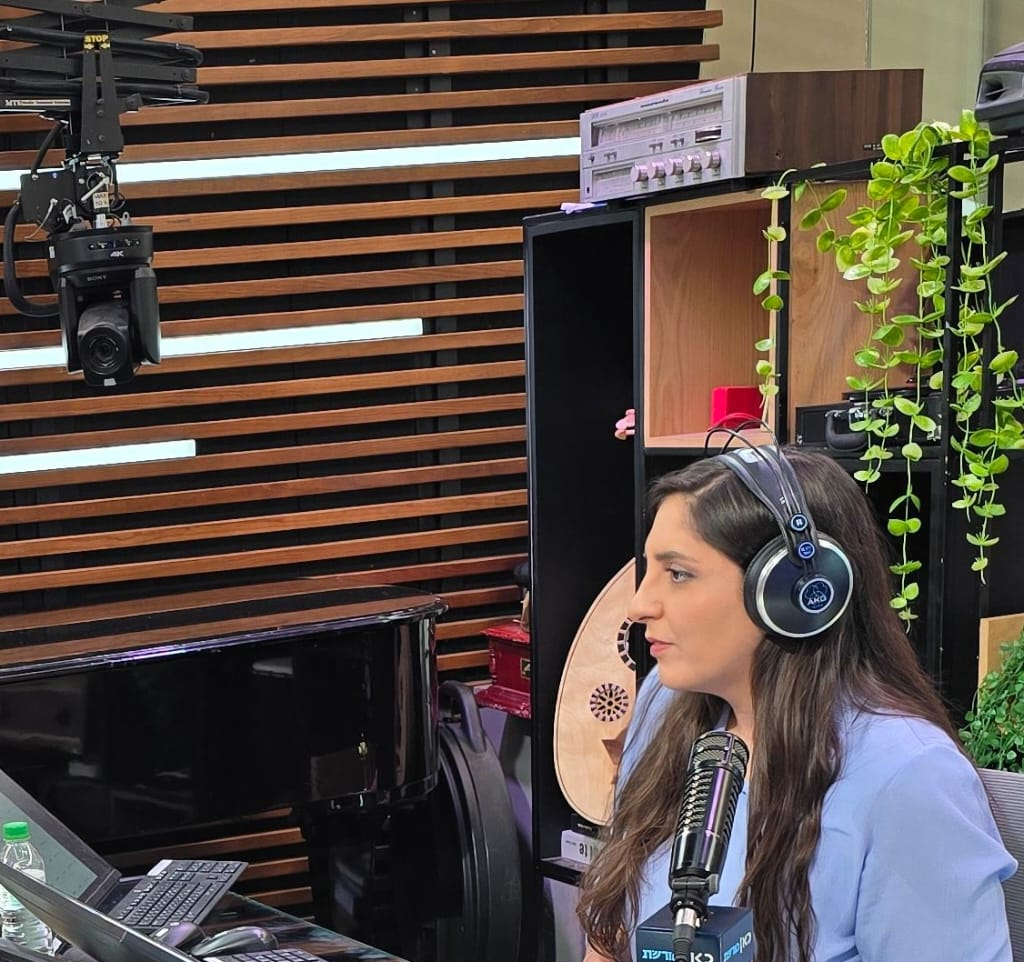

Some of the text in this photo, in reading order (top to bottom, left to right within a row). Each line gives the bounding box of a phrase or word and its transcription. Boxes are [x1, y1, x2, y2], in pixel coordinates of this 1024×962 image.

[84, 34, 109, 43] STOP
[87, 274, 107, 282] SONY
[807, 596, 827, 605] AKG
